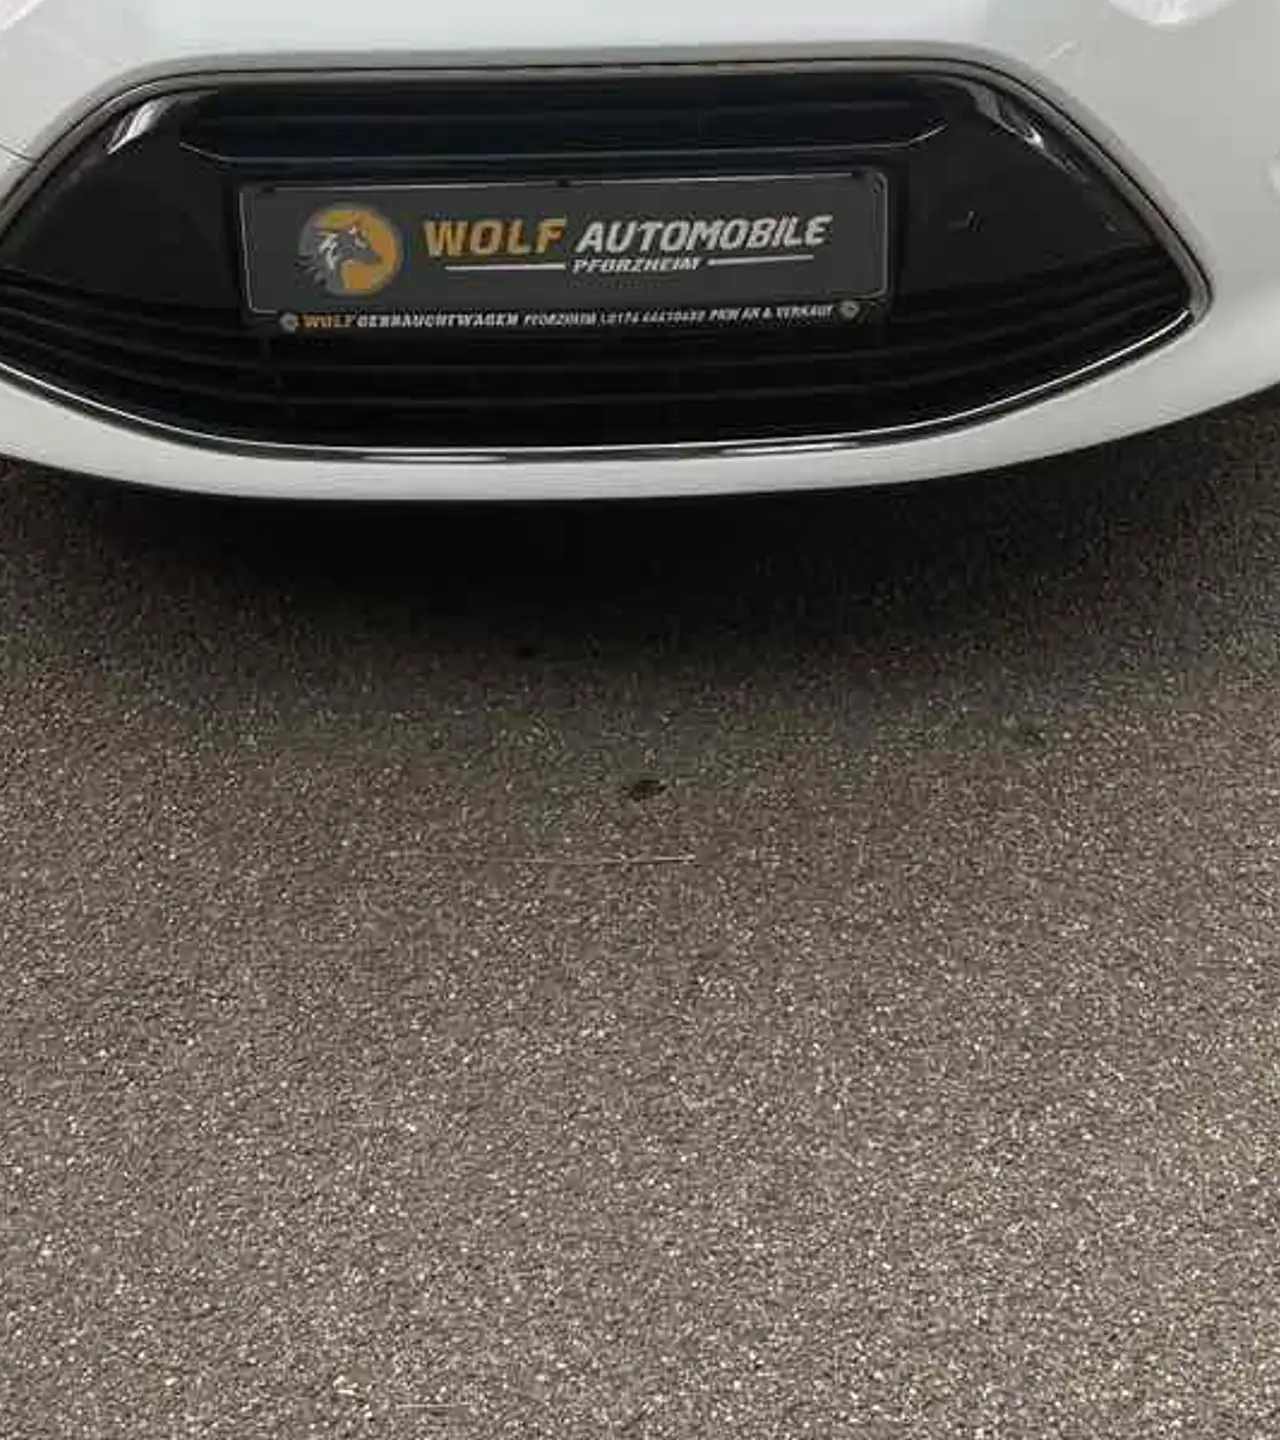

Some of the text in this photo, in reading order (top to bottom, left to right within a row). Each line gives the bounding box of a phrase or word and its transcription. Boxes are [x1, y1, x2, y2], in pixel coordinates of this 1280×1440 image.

[424, 215, 833, 257] WOLF AUTOMOBILE
[572, 256, 702, 274] PFORZHEIM
[301, 312, 354, 328] WOLF
